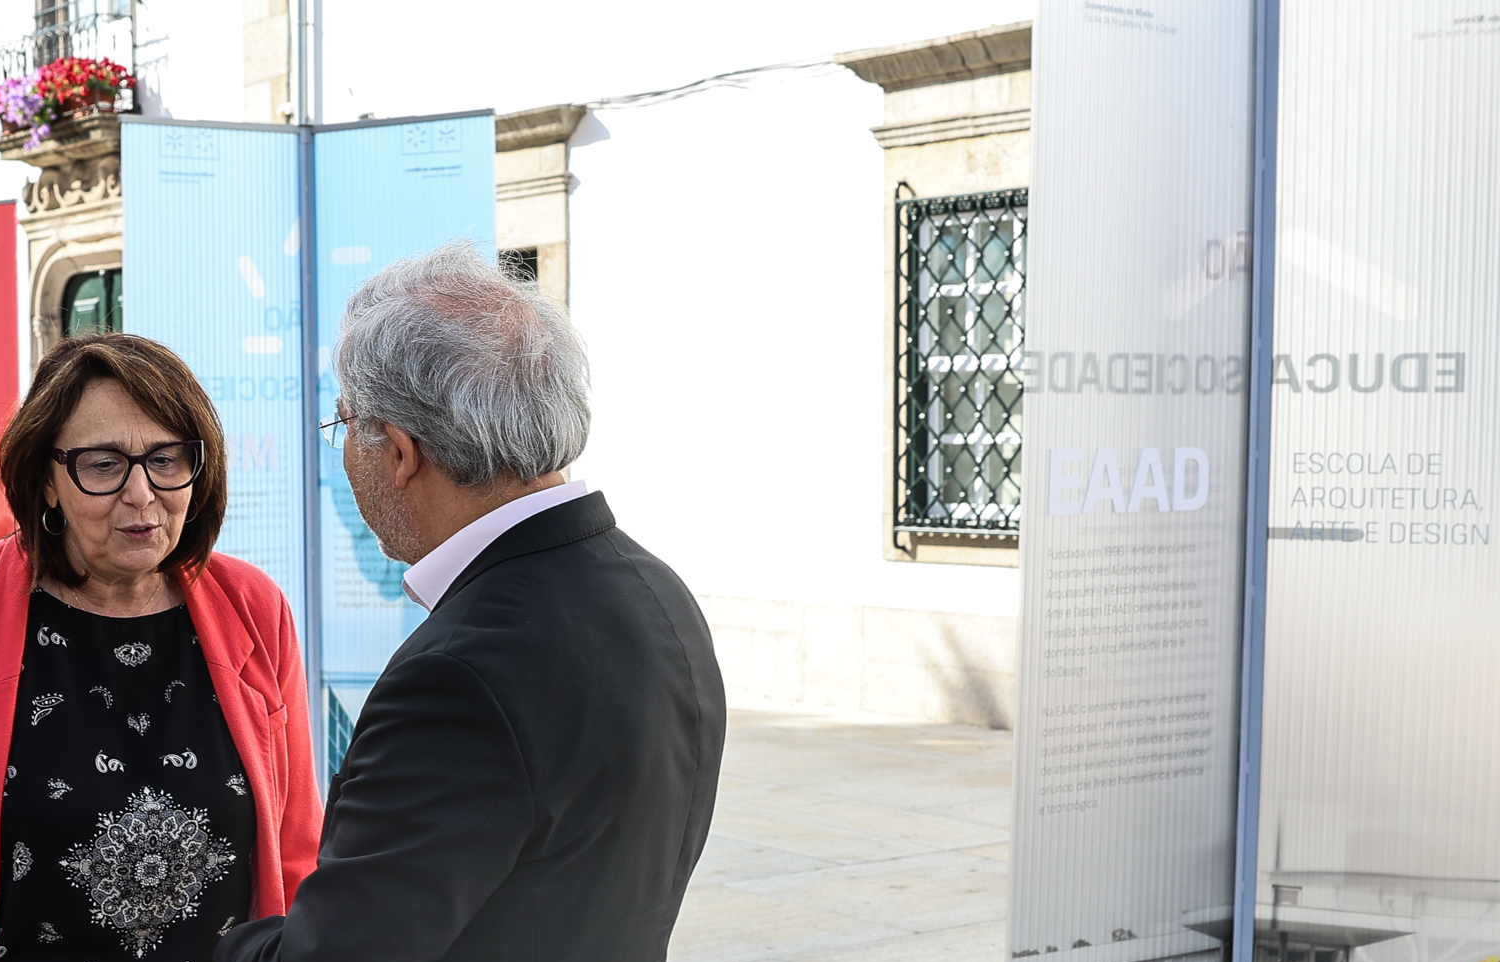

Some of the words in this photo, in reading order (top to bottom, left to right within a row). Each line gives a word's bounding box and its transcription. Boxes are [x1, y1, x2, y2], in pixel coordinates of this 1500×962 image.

[1293, 452, 1397, 475] ESCOLA
[1407, 453, 1442, 475] DE
[1048, 447, 1210, 516] EAAD
[1291, 486, 1484, 512] ARQUITETURA,
[1290, 520, 1355, 543] ARTE
[1366, 522, 1379, 543] E
[1390, 522, 1490, 545] DESIGN
